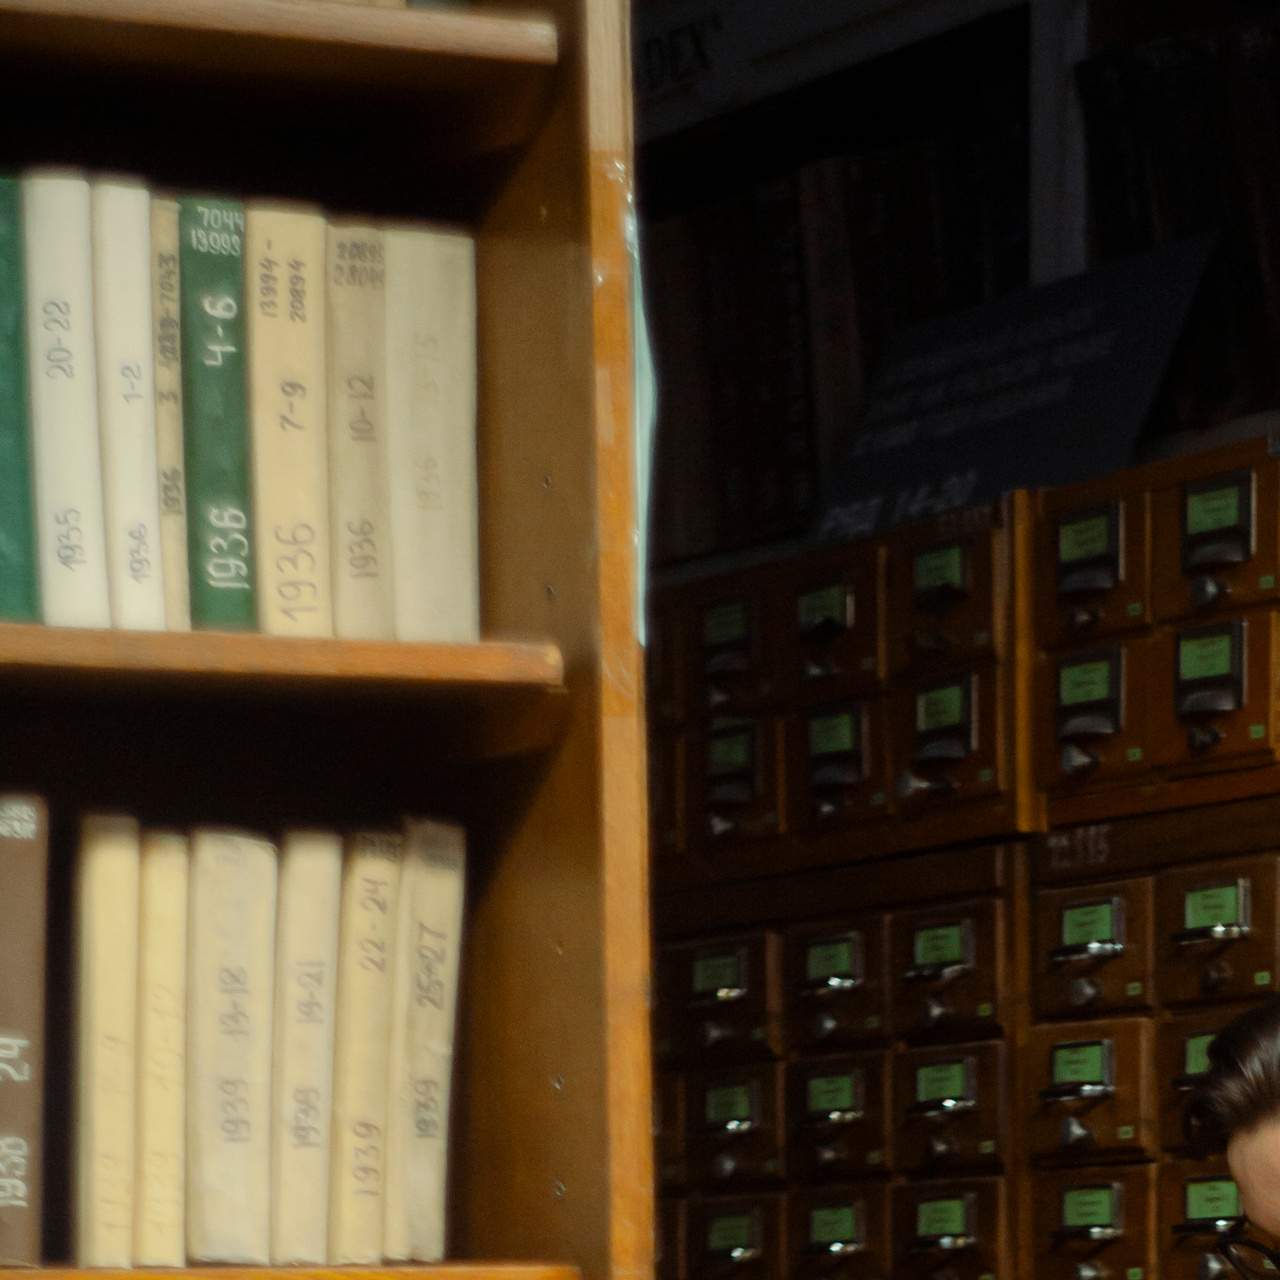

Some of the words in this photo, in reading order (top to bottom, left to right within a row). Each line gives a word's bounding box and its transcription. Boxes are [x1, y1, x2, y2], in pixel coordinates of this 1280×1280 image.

[44, 300, 74, 379] 20-22
[202, 296, 237, 366] 4-6
[121, 363, 142, 405] 1-2
[159, 390, 178, 407] 3
[280, 380, 307, 433] 7-9
[348, 374, 376, 443] 10-12
[56, 507, 82, 571] 1935
[129, 522, 150, 584] 1936
[207, 506, 249, 589] 1936
[273, 522, 319, 622] 1936
[347, 518, 378, 578] 1936
[416, 920, 448, 1011] 25-27
[218, 966, 249, 1037] 13-18
[220, 1078, 251, 1143] 1939
[351, 1121, 381, 1197] 1939
